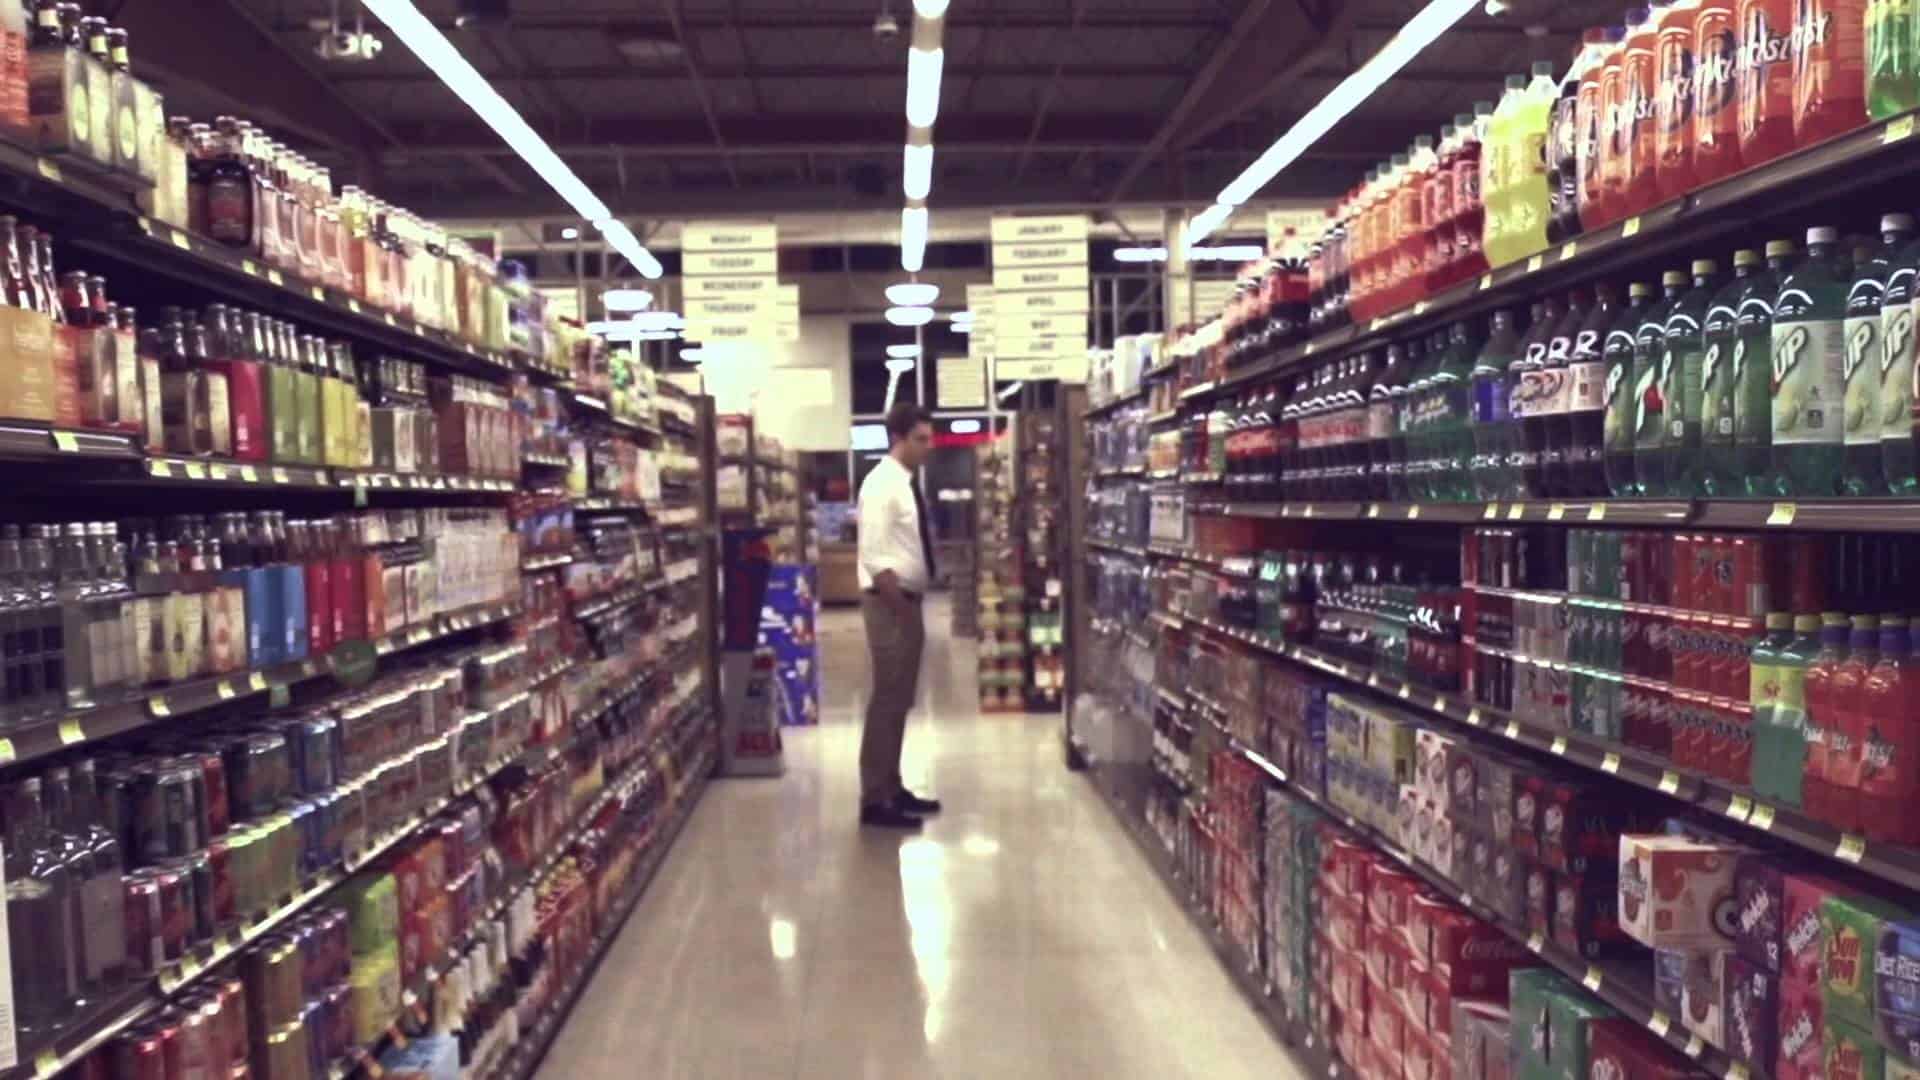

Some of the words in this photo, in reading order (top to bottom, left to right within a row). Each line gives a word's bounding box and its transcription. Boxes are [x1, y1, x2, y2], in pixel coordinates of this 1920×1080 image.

[1018, 224, 1063, 234] JANUARY
[711, 235, 752, 244] MONDAY
[1013, 248, 1067, 258] FEBRUARY
[709, 258, 755, 268] TUESDAY
[1022, 273, 1059, 283] MARCH
[702, 281, 763, 291] WEDNESDAY
[1026, 297, 1054, 306] APRIL
[702, 303, 757, 313] THURSDAY
[1031, 320, 1050, 329] MAY
[711, 326, 747, 337] FRIDAY
